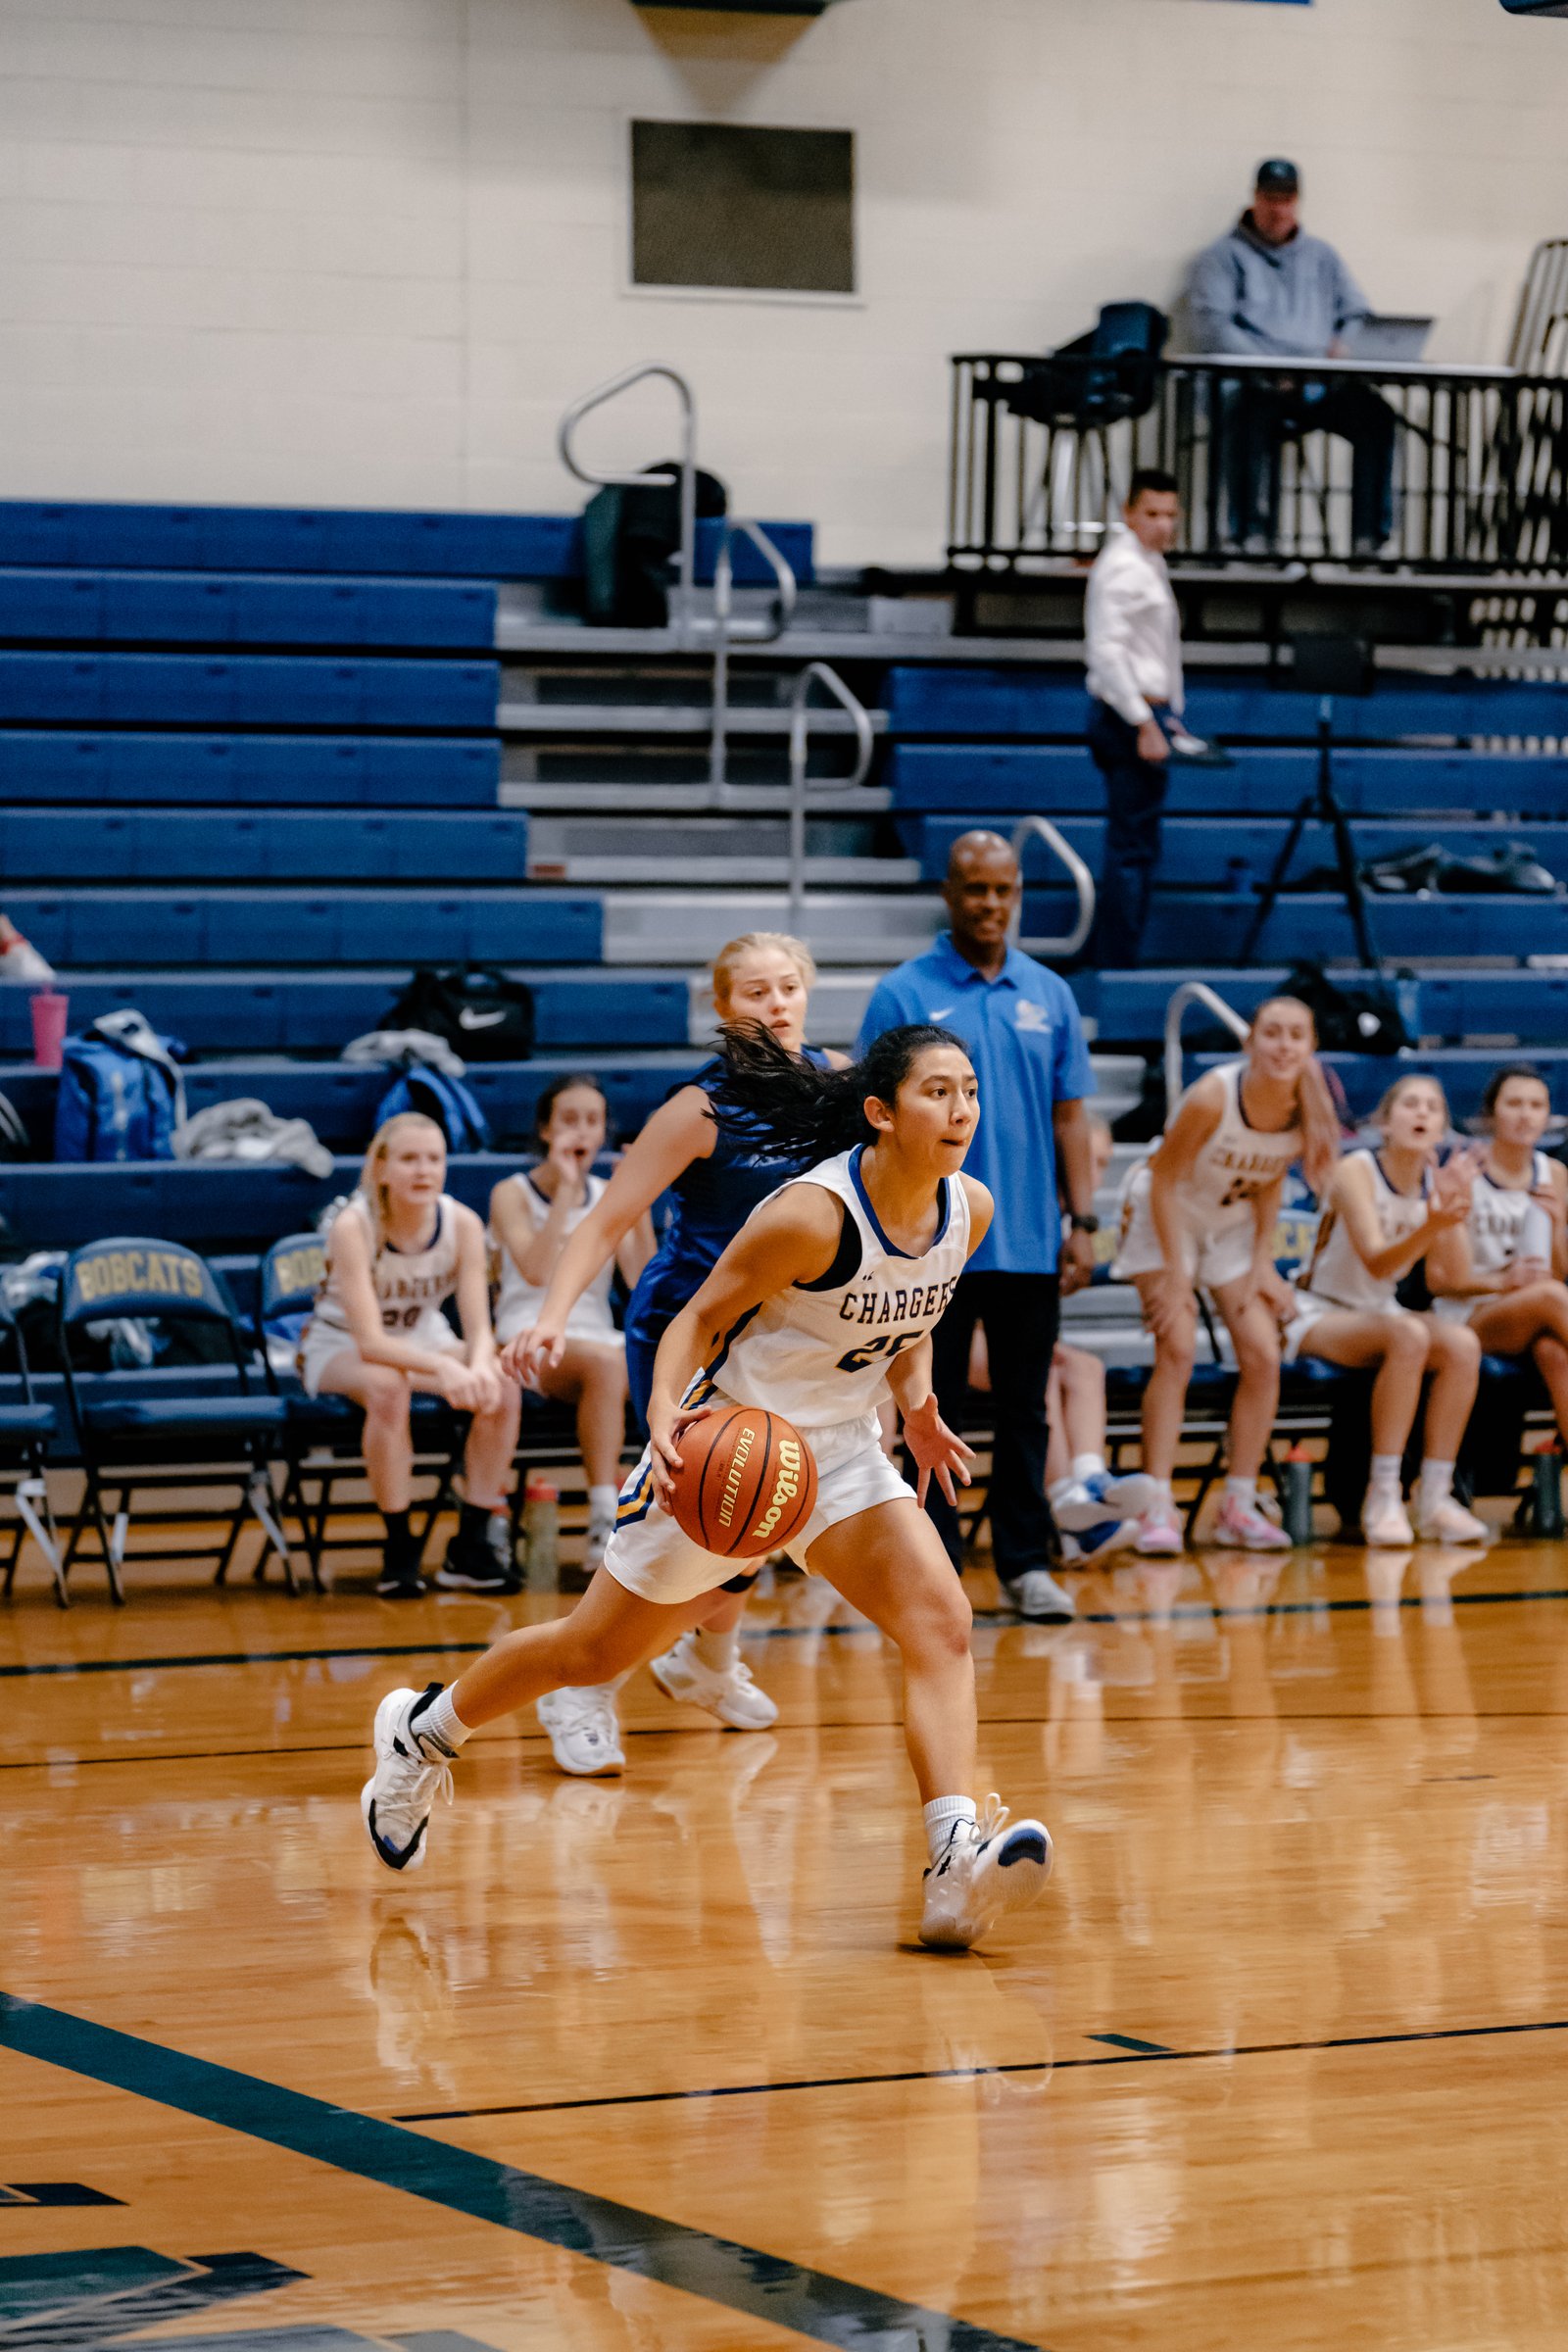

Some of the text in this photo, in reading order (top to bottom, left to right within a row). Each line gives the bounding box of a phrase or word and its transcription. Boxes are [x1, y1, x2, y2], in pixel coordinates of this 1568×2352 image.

[75, 1250, 203, 1301] BOBCATS
[718, 1427, 756, 1528] EVOLUTION
[752, 1440, 801, 1539] Wilson
